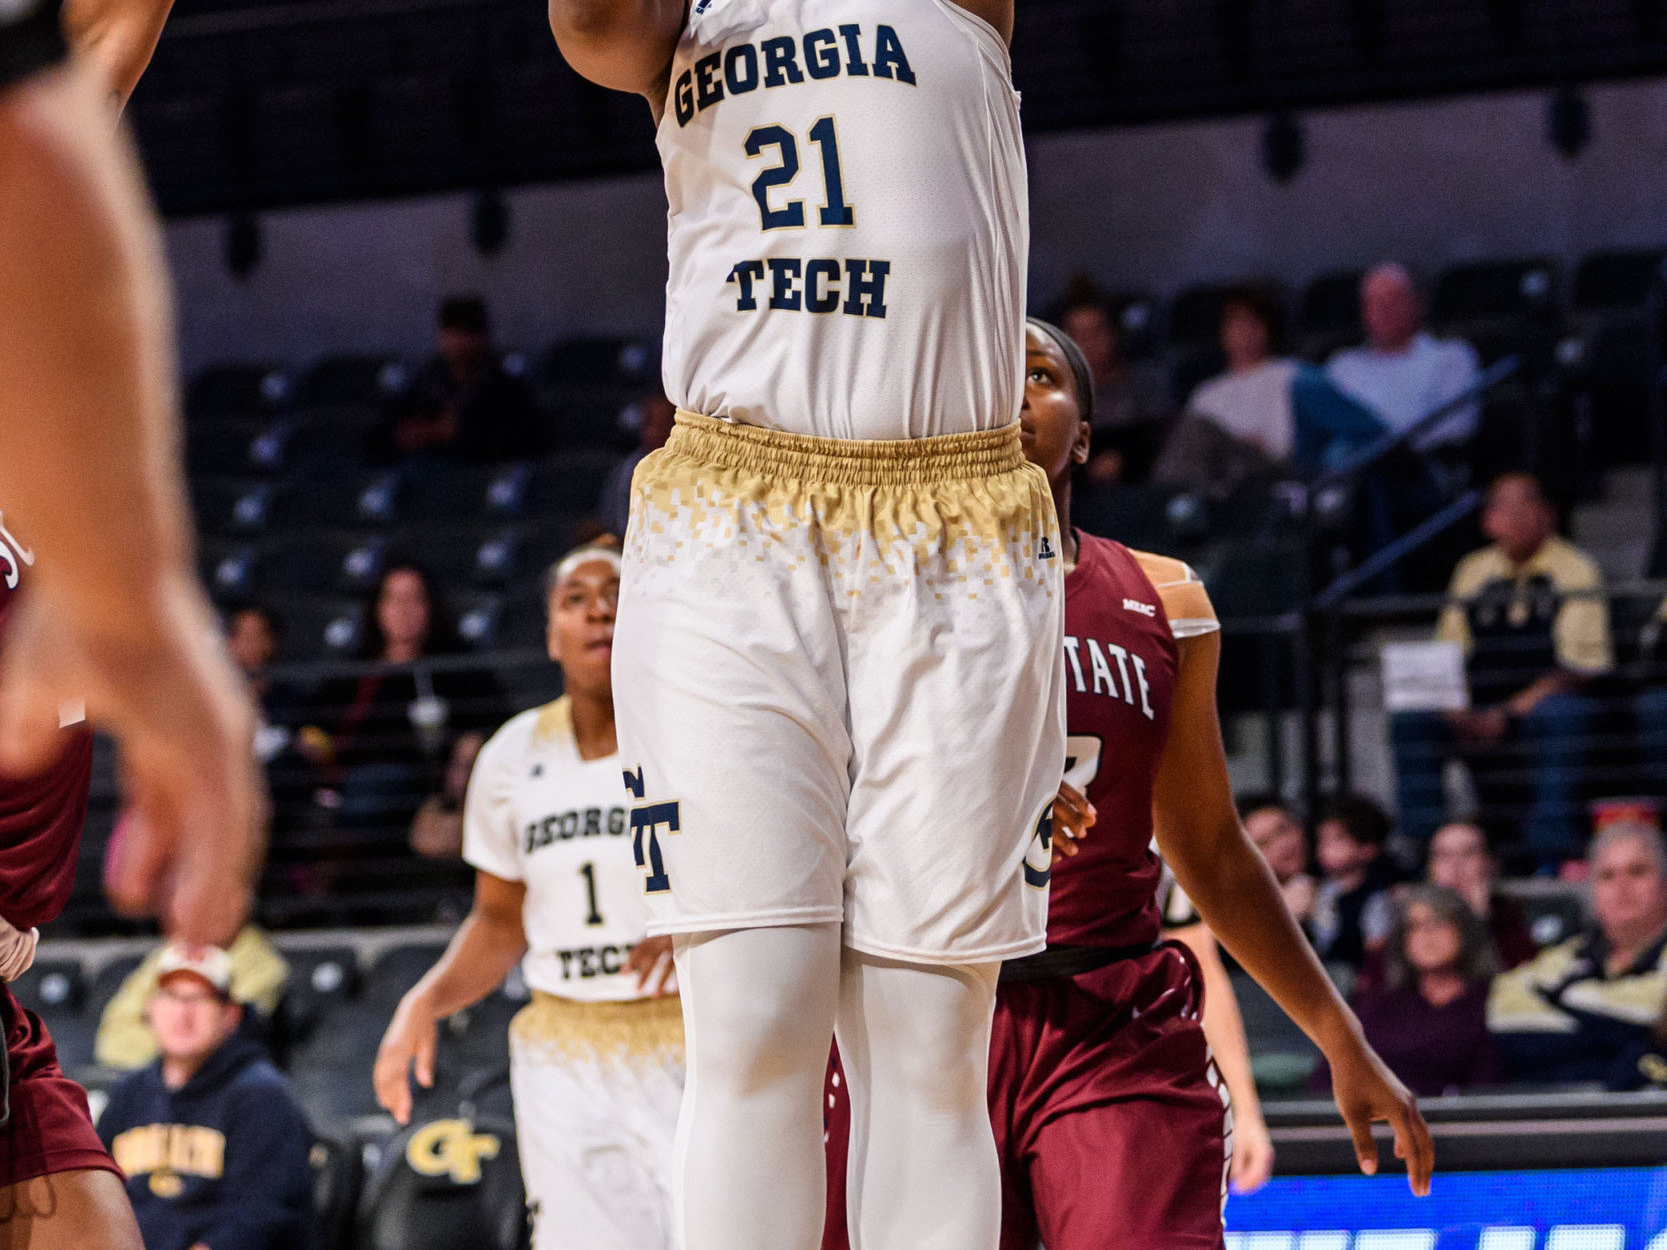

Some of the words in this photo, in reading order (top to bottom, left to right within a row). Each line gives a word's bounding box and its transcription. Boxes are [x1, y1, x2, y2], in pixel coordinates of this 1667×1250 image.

[674, 23, 918, 128] GEORGIA
[741, 113, 857, 234] 21
[725, 257, 891, 319] TECH
[1064, 636, 1155, 720] TATE
[525, 806, 630, 854] GEORG
[579, 862, 604, 927] 1
[557, 945, 638, 980] TEC
